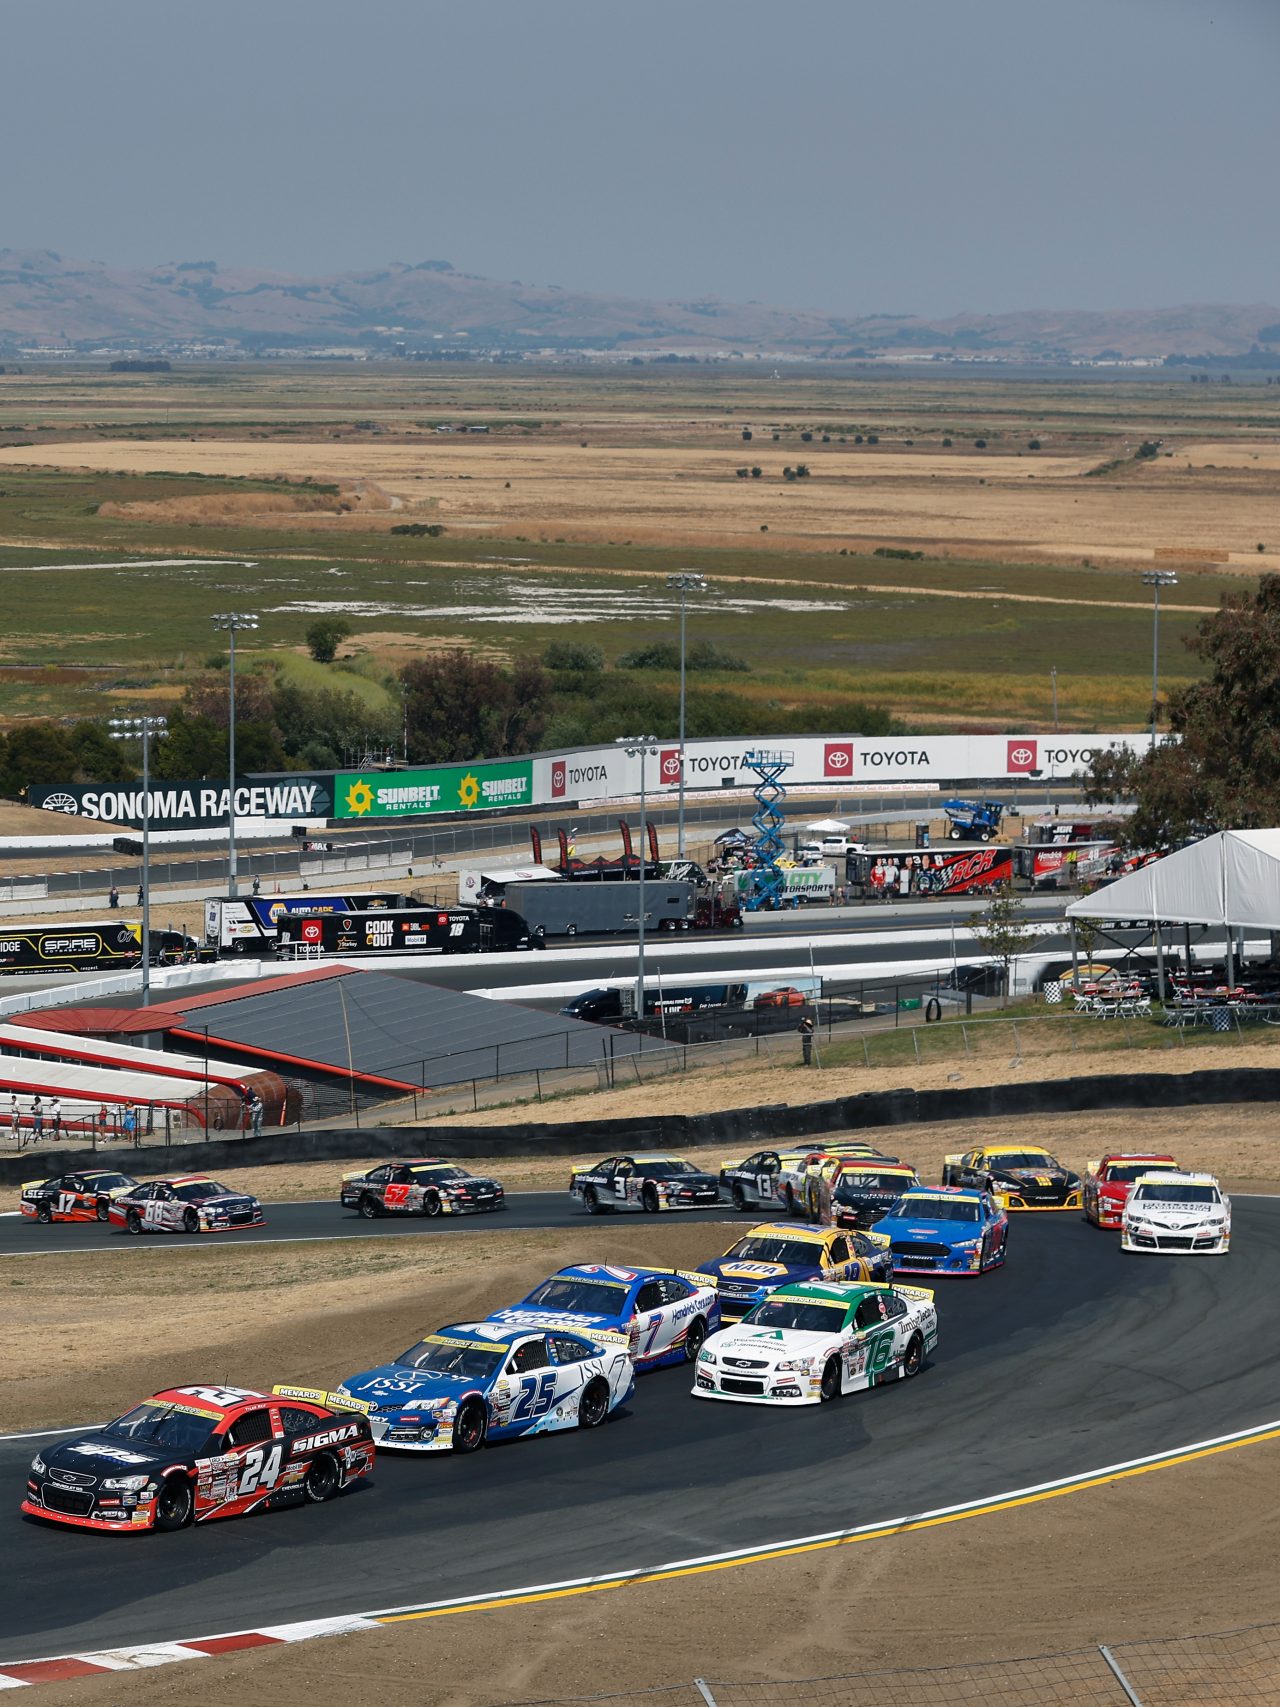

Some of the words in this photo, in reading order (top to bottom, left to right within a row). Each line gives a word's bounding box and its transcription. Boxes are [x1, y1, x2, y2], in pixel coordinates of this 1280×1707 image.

[689, 756, 751, 772] TOYOTA
[861, 751, 930, 766] TOYOTA
[1045, 749, 1102, 763] TOYO
[569, 765, 607, 784] TOYOTA
[377, 785, 440, 804] SUNBELT
[482, 777, 527, 797] SUNBELT
[81, 790, 196, 821] SONOMA
[200, 785, 317, 817] RACEWAY
[386, 802, 431, 810] RENTALS
[488, 794, 521, 802] RENTALS
[934, 855, 944, 866] 8
[948, 849, 997, 886] RCR
[365, 920, 394, 934] COOK
[449, 923, 464, 937] 18
[117, 930, 137, 943] 07
[384, 1183, 411, 1204] 52
[613, 1176, 626, 1198] 3
[756, 1174, 771, 1197] 13
[59, 1193, 77, 1213] 17
[145, 1199, 164, 1222] 68
[677, 1271, 715, 1284] MENARDS
[728, 1262, 778, 1276] NAPA
[893, 1286, 930, 1299] MENARDS
[491, 1309, 607, 1323] Hendrick
[591, 1333, 628, 1345] MENARDS
[642, 1311, 665, 1357] 7
[865, 1327, 895, 1377] 16
[279, 1388, 321, 1400] MENARDS
[357, 1377, 426, 1394] JSSI
[327, 1395, 366, 1412] MENARDS
[512, 1370, 558, 1422] 25
[368, 1415, 389, 1423] MRY
[292, 1424, 359, 1454] SIGMA
[238, 1445, 282, 1495] 24
